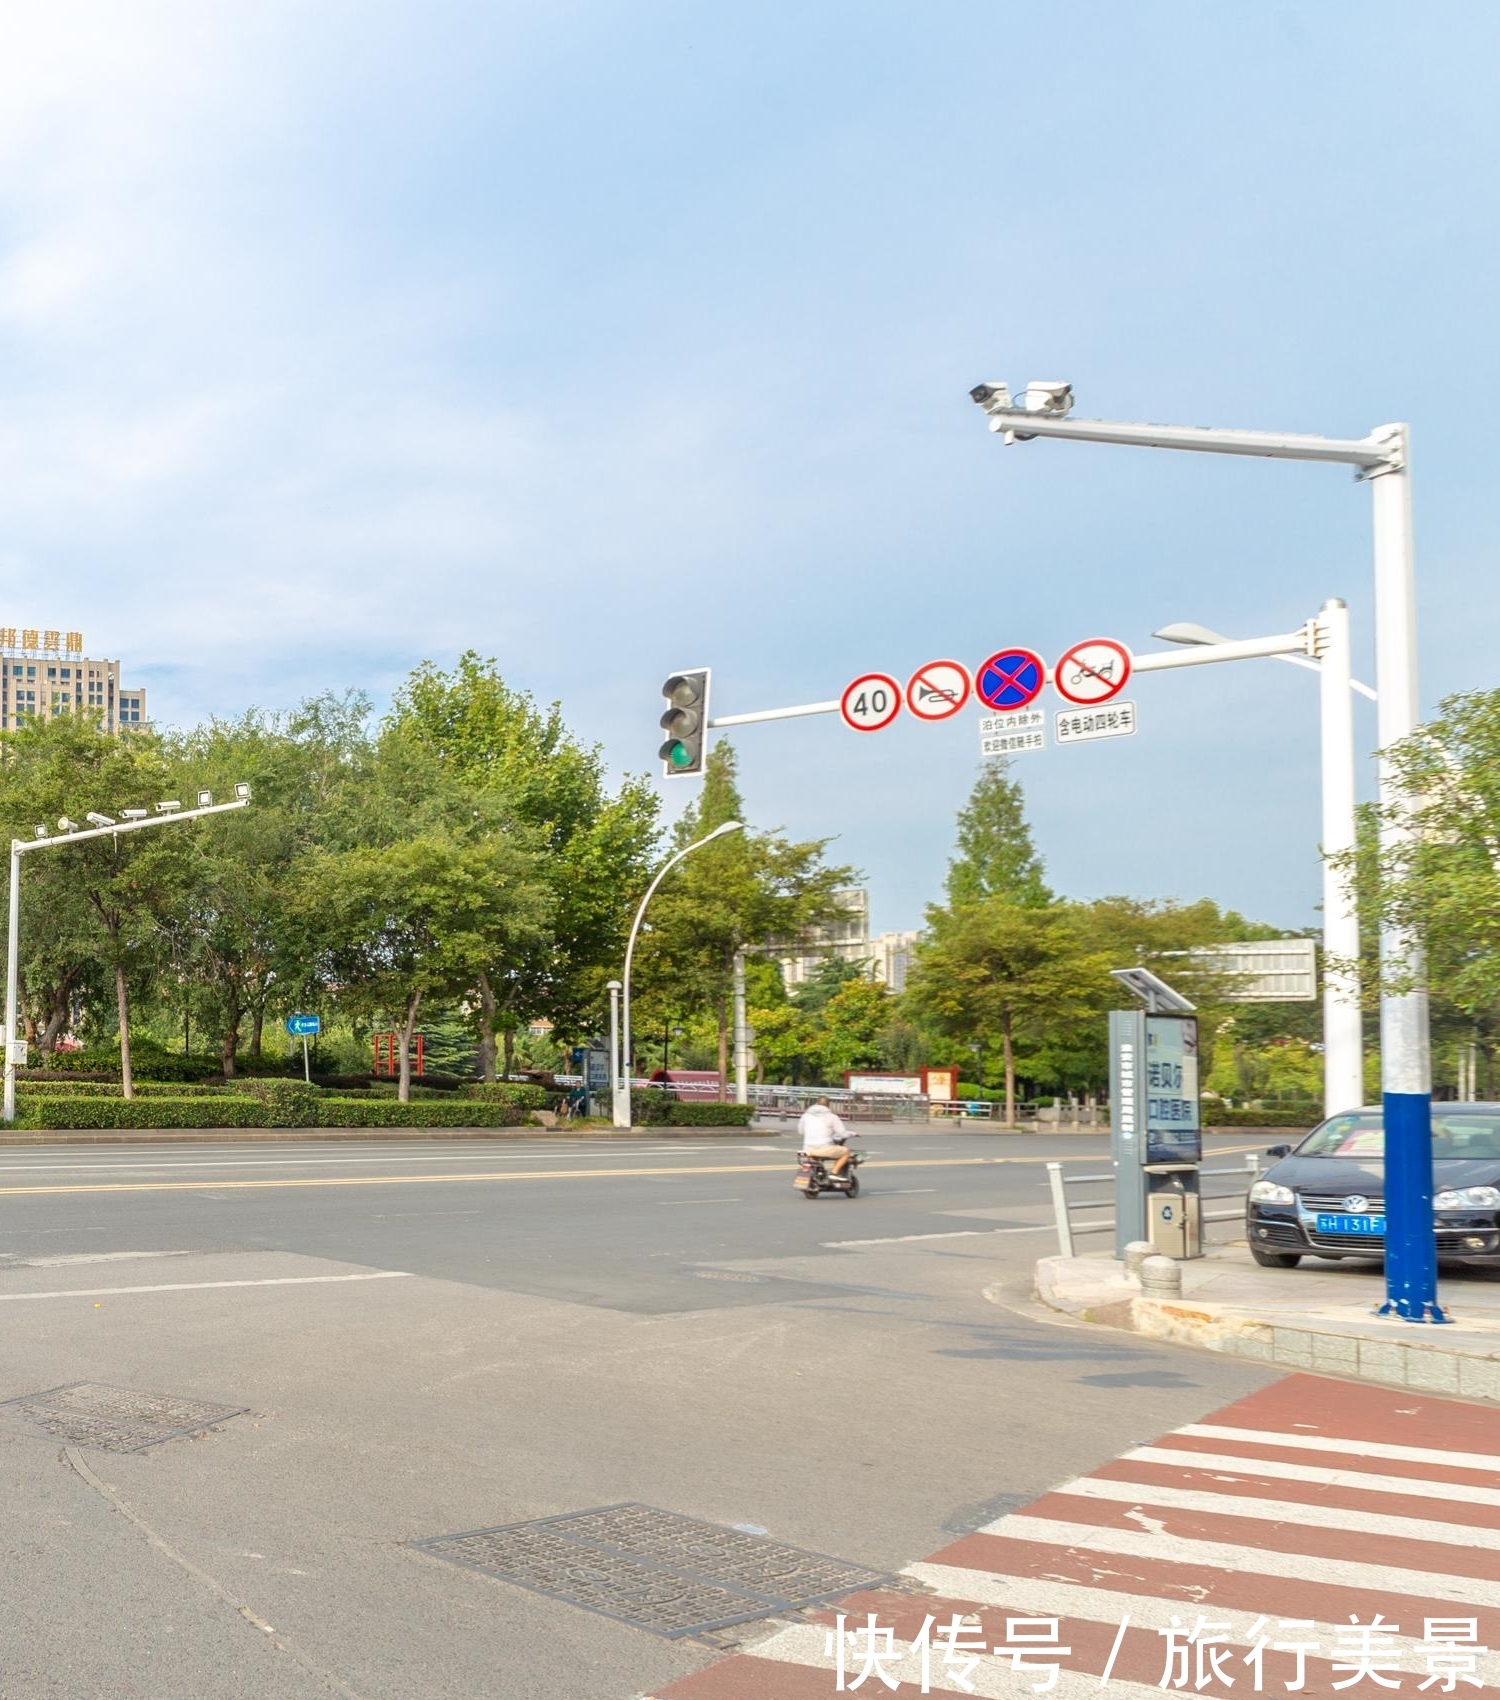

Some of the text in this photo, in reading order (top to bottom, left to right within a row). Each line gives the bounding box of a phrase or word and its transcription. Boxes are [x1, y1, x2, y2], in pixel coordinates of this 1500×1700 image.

[853, 690, 887, 716] 40
[982, 713, 1042, 731] 泊位内除外
[1059, 709, 1132, 736] 含电动四轮车
[1148, 1099, 1192, 1121] 口腔医院
